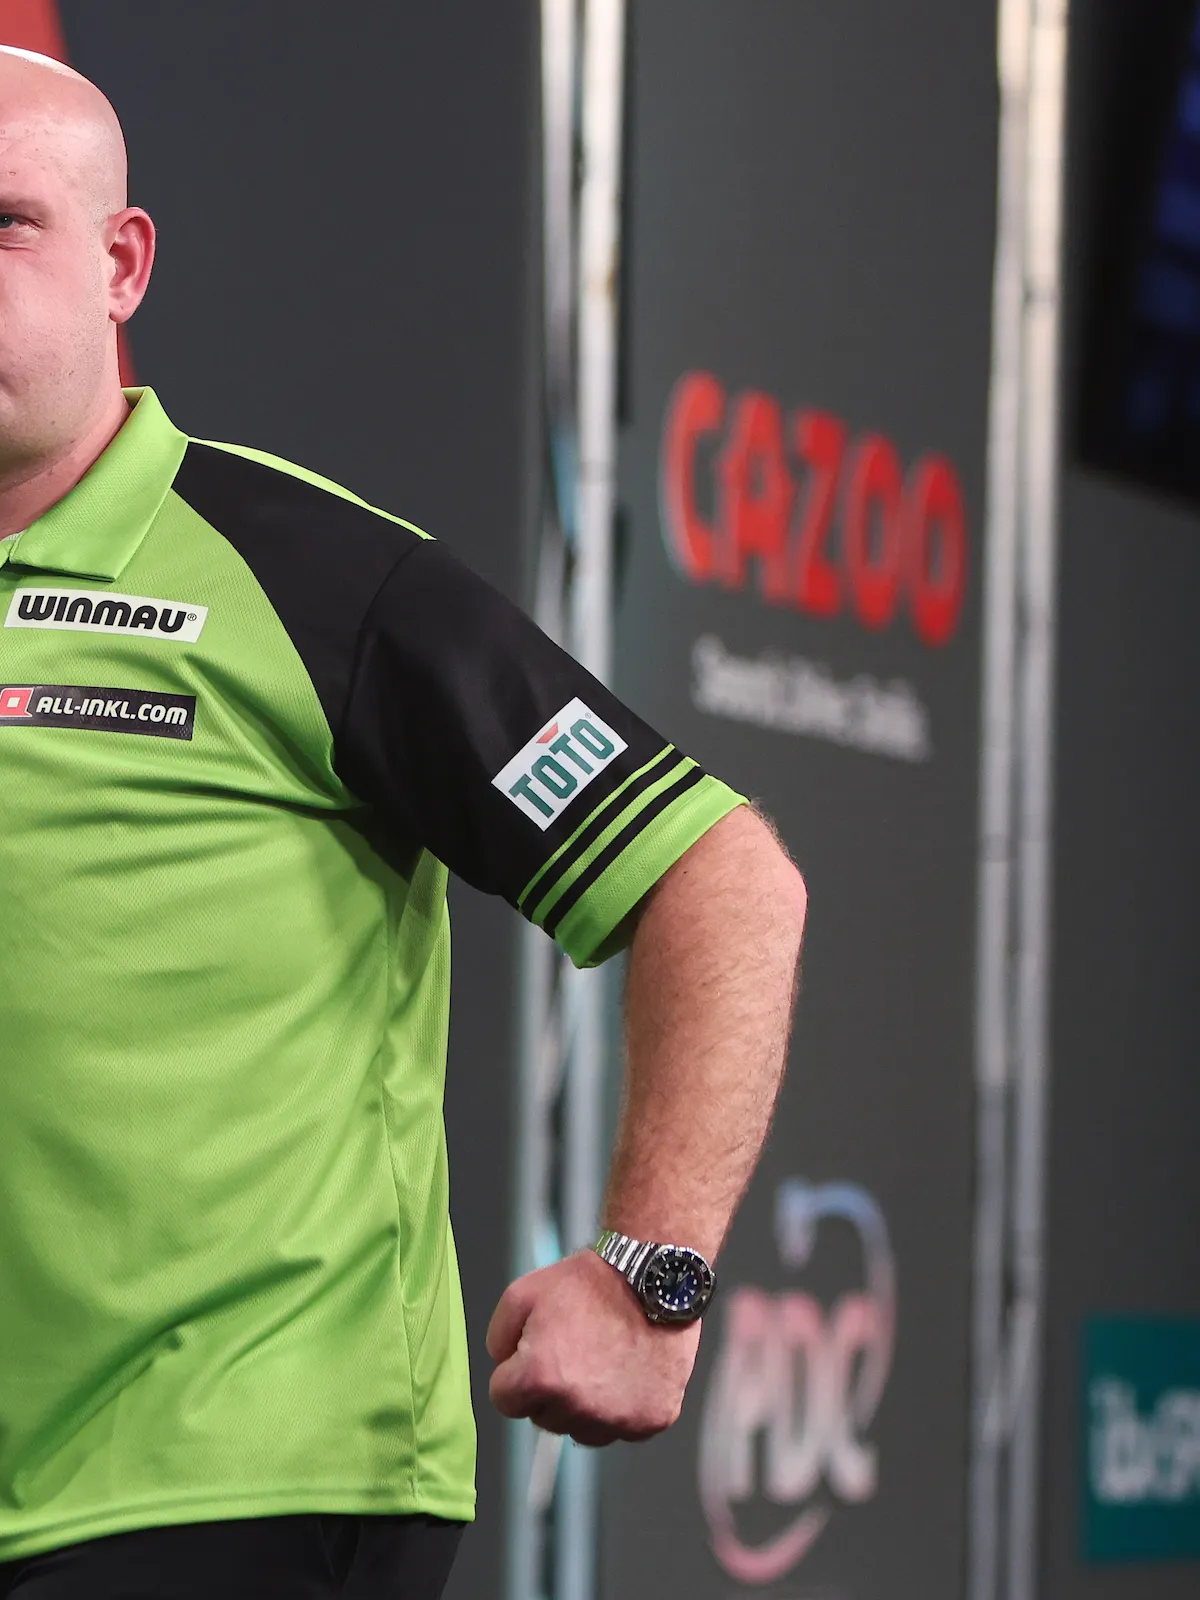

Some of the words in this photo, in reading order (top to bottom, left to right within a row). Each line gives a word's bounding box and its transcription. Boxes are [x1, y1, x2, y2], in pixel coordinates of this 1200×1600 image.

[664, 370, 966, 648] CAZOO
[35, 696, 188, 726] ALL-INKL.COM
[508, 718, 615, 819] TOTO
